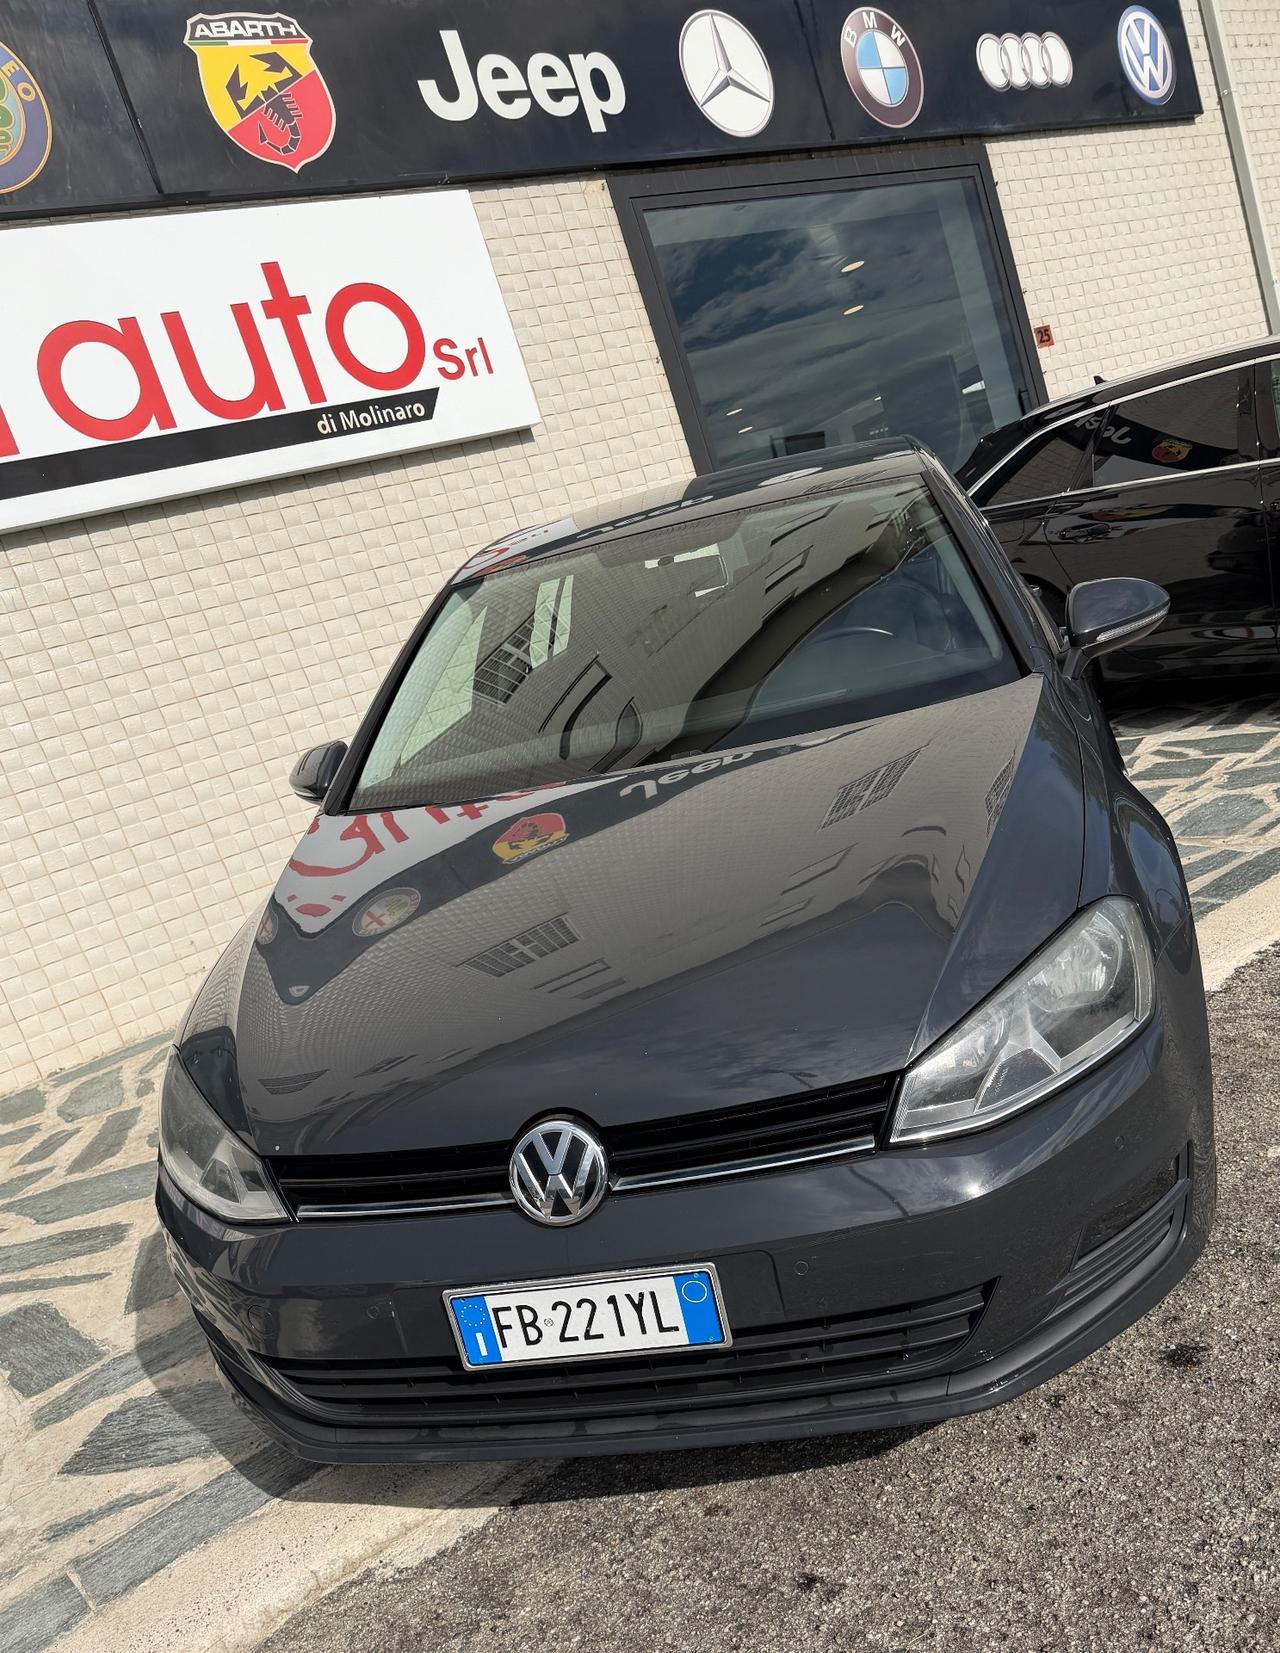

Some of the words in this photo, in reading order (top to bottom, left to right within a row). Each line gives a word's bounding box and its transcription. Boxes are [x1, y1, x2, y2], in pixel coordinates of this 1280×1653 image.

[194, 20, 298, 39] ABARTH
[843, 11, 906, 48] BMW
[417, 29, 626, 133] Jeep
[37, 261, 425, 442] auto
[432, 337, 494, 381] Srl
[1037, 328, 1051, 343] 25
[316, 413, 338, 435] di
[339, 401, 426, 431] Molinaro
